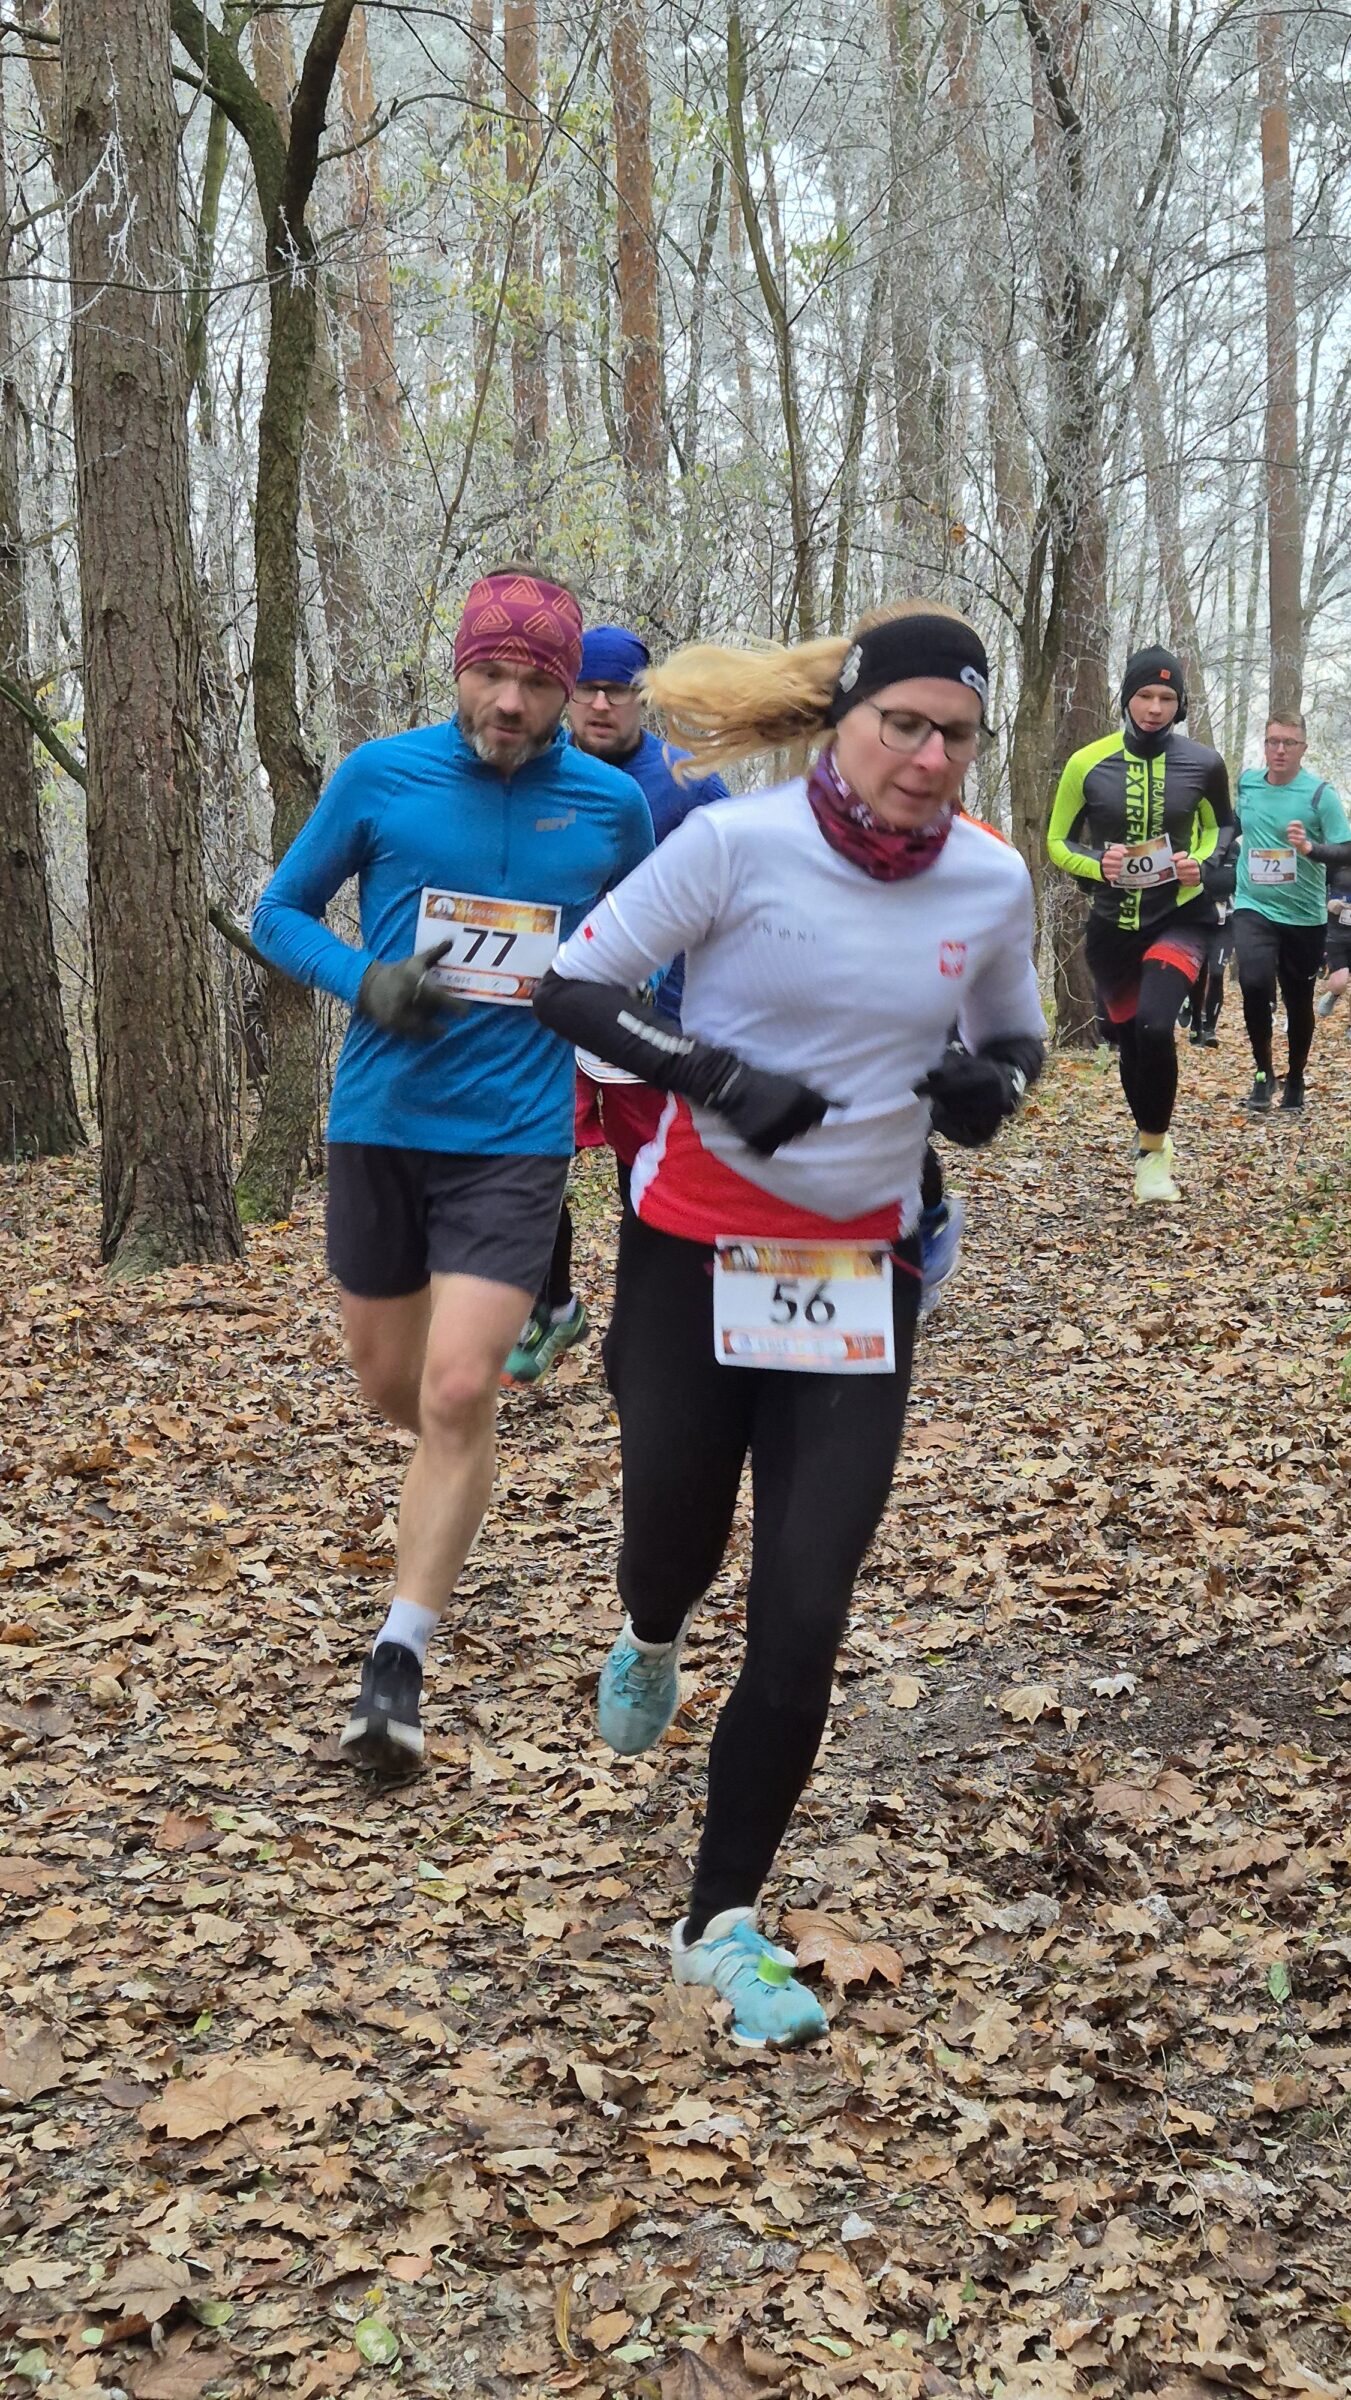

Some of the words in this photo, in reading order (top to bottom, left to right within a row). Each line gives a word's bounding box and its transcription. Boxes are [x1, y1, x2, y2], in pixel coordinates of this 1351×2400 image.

[1126, 762, 1144, 845] EXTREM
[1151, 779, 1165, 838] RUNNING
[1127, 856, 1153, 874] 60
[1262, 859, 1281, 873] 72
[462, 927, 518, 967] 77
[769, 1279, 836, 1325] 56
